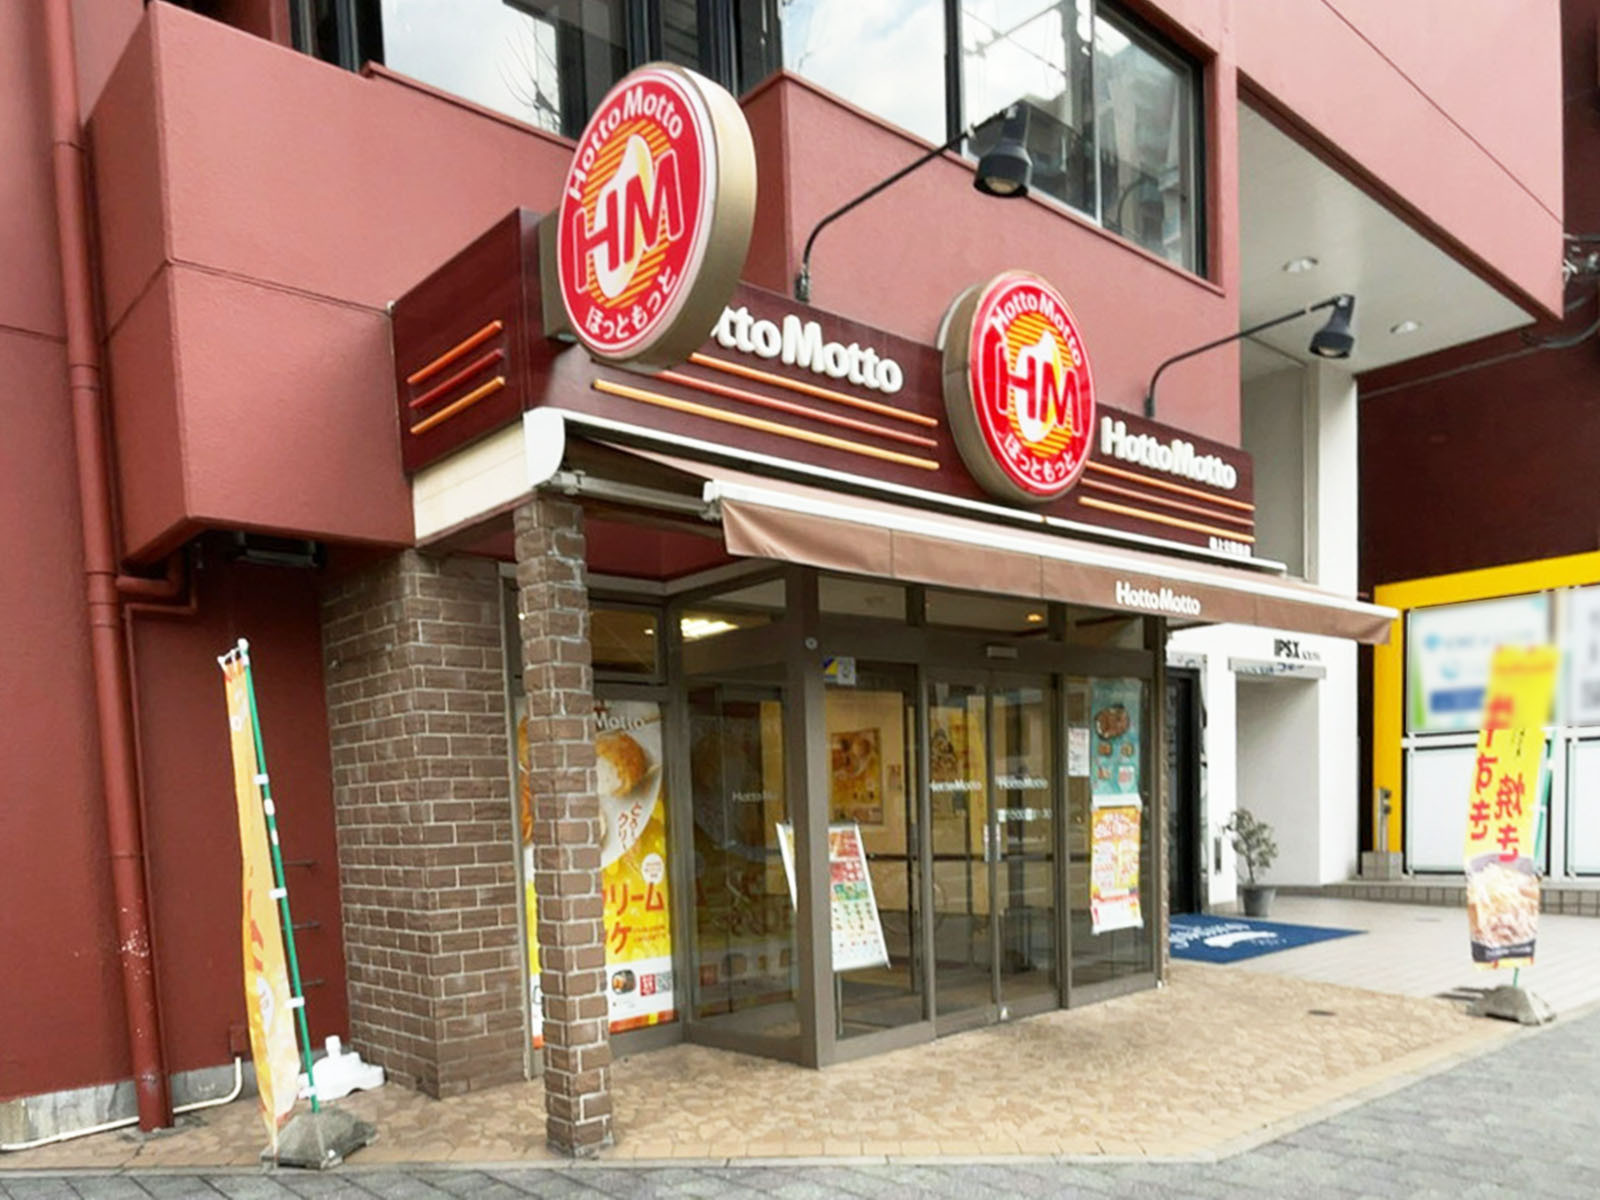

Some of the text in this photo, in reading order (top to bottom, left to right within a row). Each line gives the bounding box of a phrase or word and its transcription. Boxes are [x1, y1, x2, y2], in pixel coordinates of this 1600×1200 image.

[585, 265, 677, 339] ほっともっと
[1003, 432, 1076, 483] ほっともっと
[1101, 416, 1237, 490] HottoMotto
[1115, 580, 1201, 616] HottoMotto
[602, 882, 665, 916] リーム
